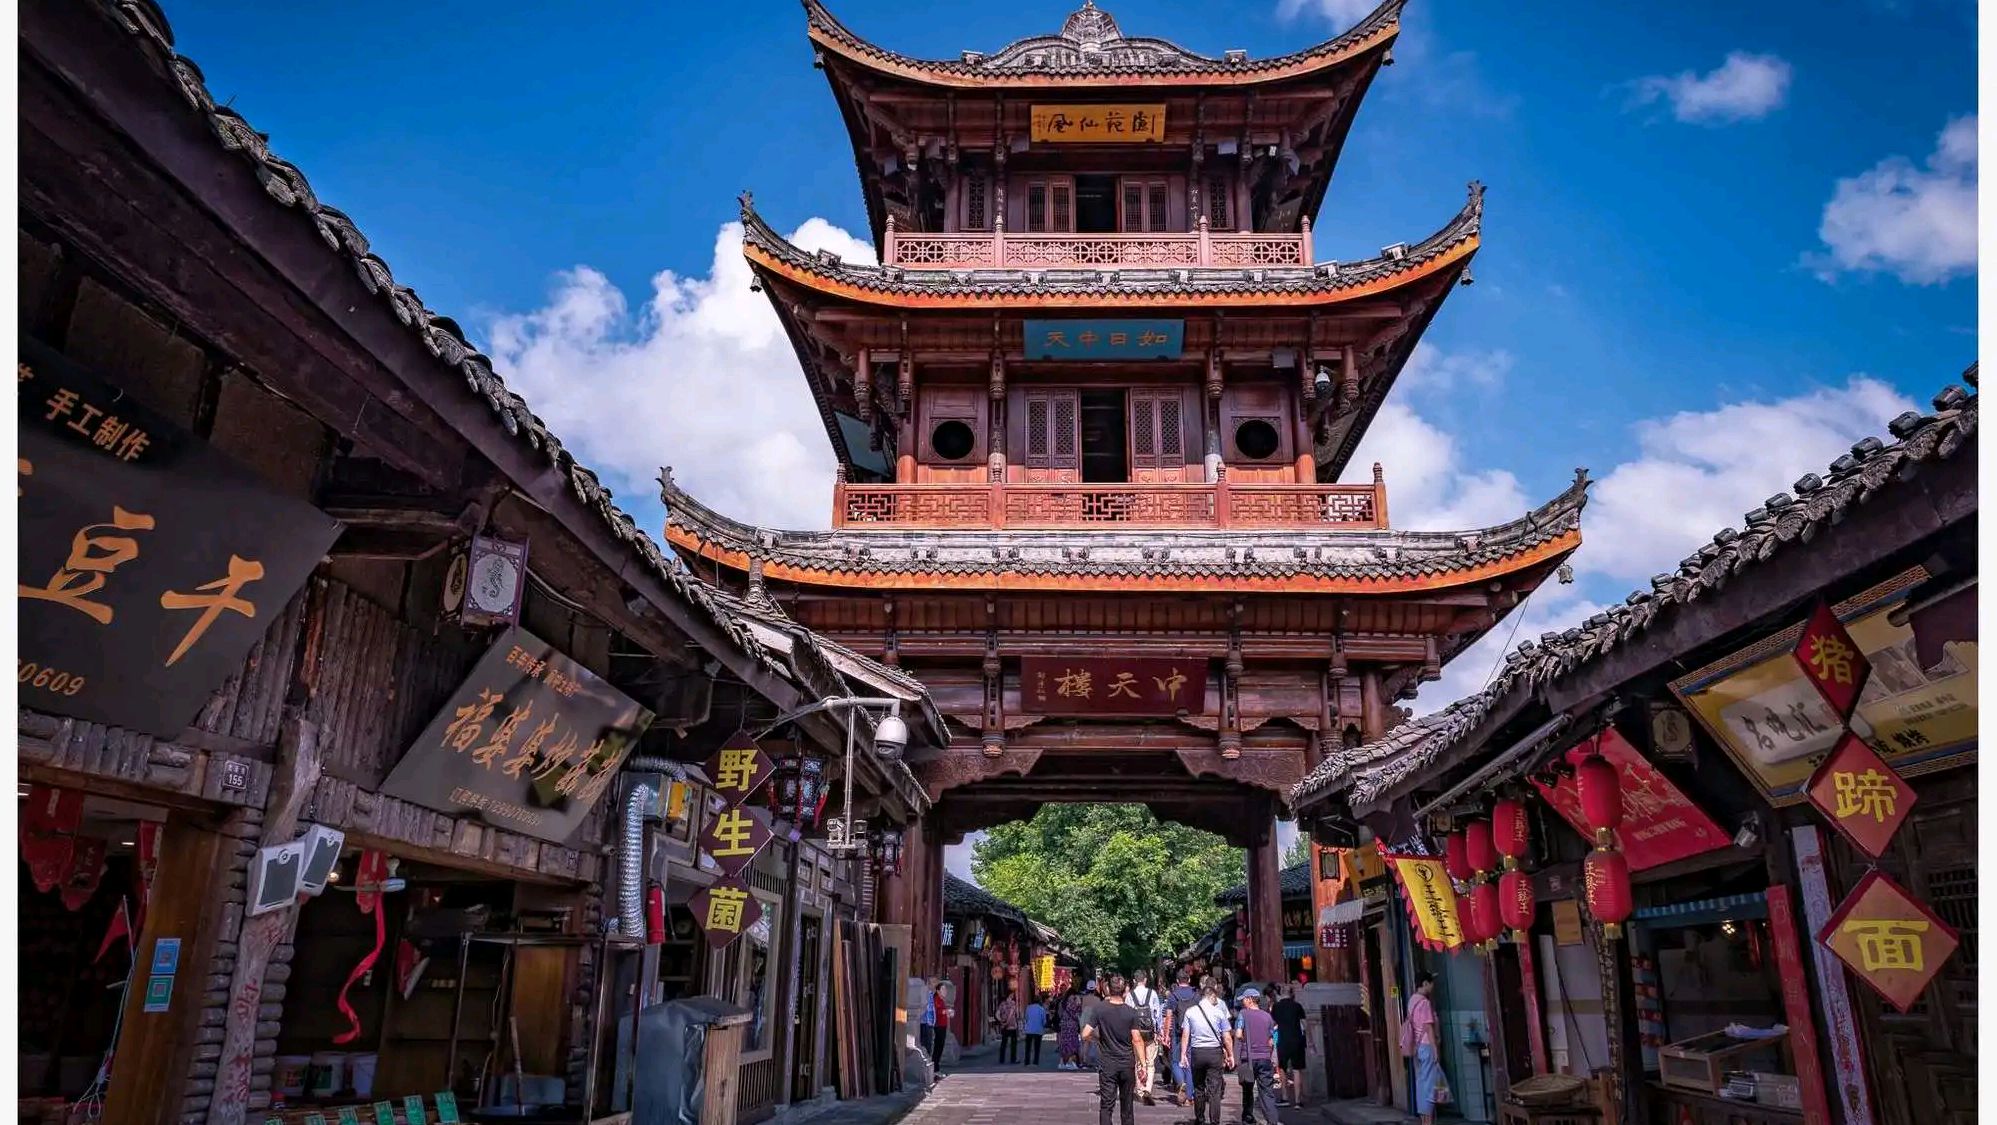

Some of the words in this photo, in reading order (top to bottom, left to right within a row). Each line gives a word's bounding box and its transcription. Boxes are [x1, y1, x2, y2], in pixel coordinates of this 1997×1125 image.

[46, 387, 151, 462] 手工制作
[18, 657, 85, 696] 0609
